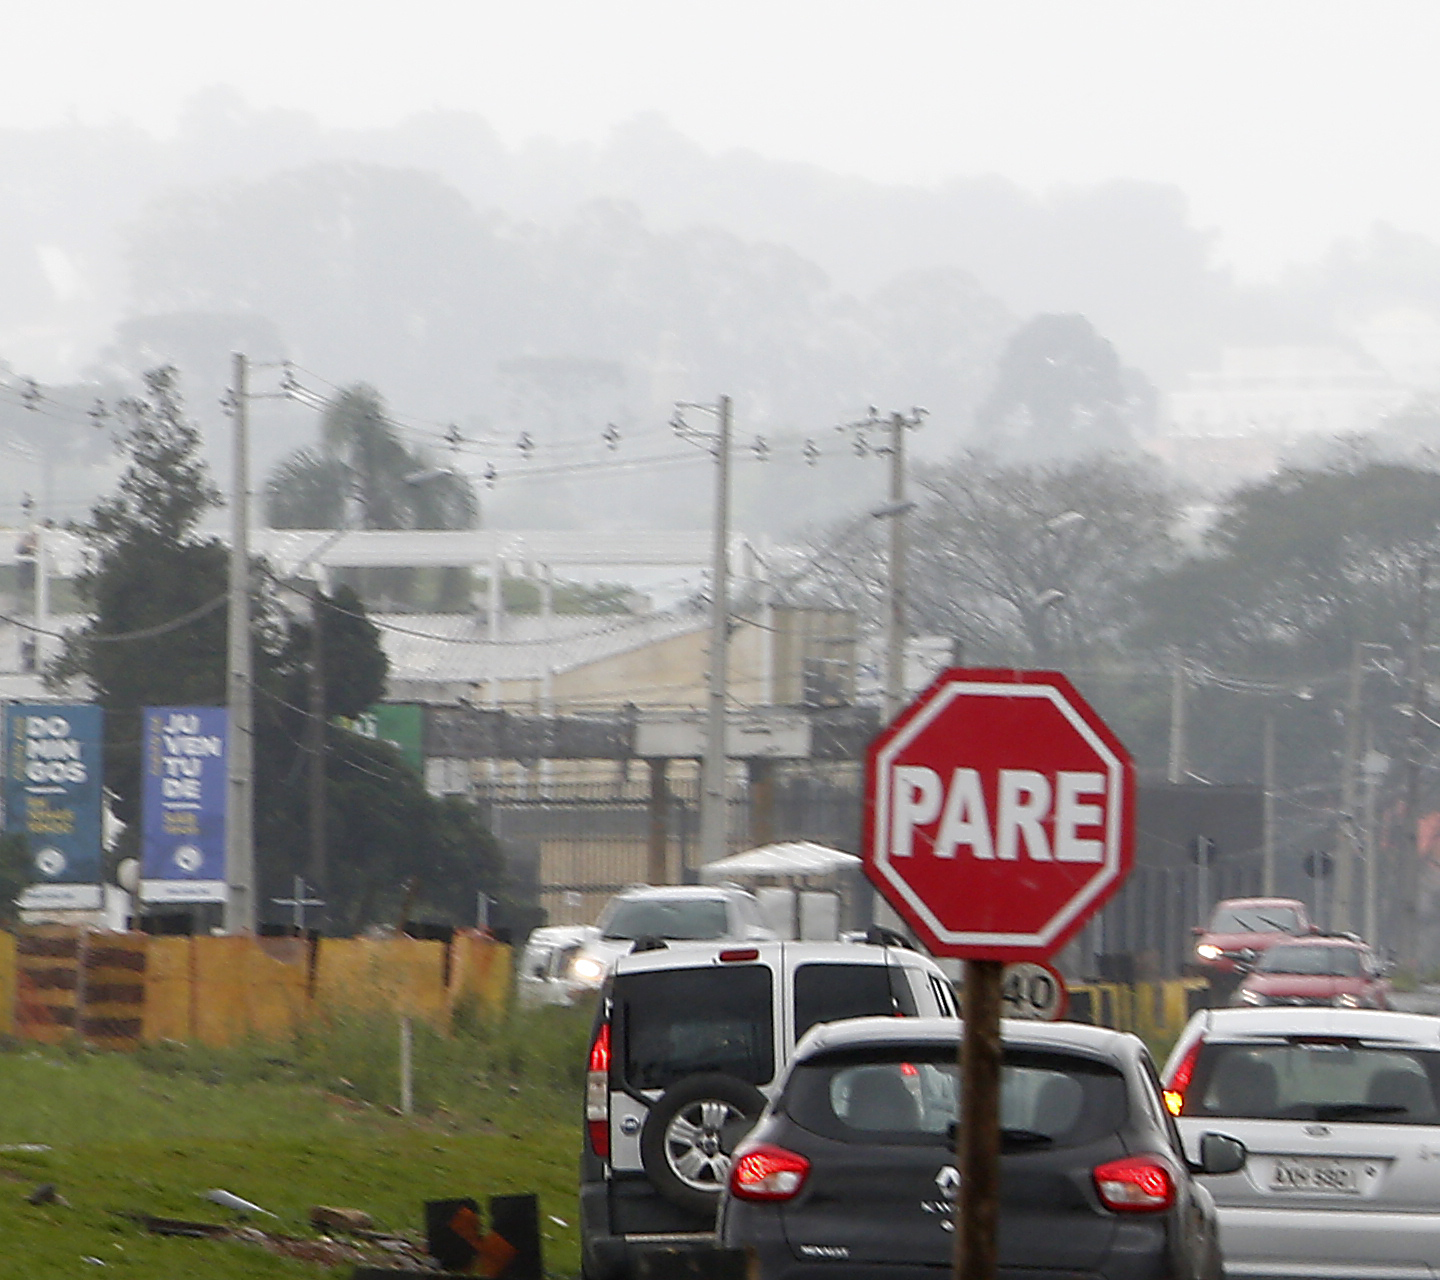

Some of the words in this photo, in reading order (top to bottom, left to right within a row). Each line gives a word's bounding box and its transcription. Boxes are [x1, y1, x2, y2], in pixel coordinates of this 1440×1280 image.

[25, 715, 71, 738] DO
[162, 713, 201, 736] JU
[162, 734, 223, 758] VEN
[162, 756, 202, 778] TU
[162, 777, 202, 799] DE
[891, 766, 1106, 862] PARE
[1001, 973, 1056, 1010] 40
